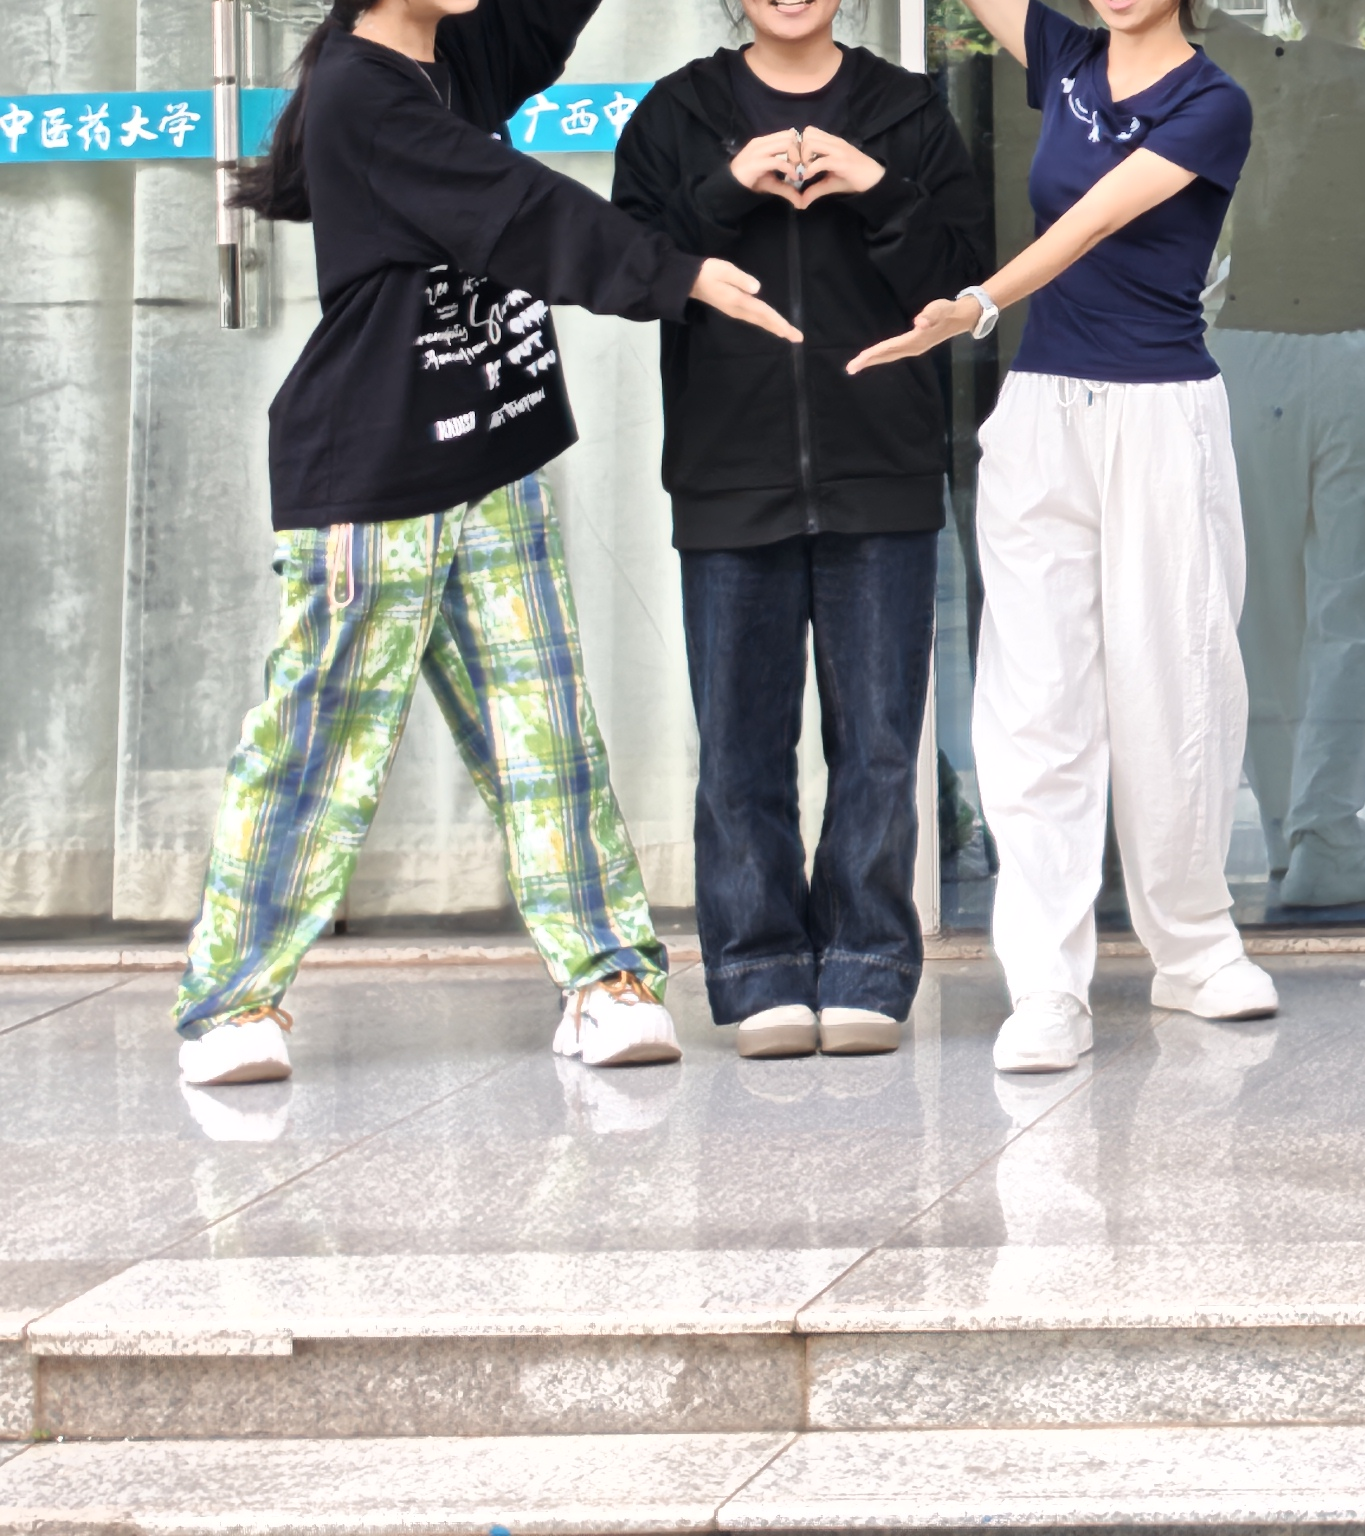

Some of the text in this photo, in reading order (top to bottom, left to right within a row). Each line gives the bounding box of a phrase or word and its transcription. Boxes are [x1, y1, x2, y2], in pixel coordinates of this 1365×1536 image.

[0, 102, 201, 154] 中医药大学
